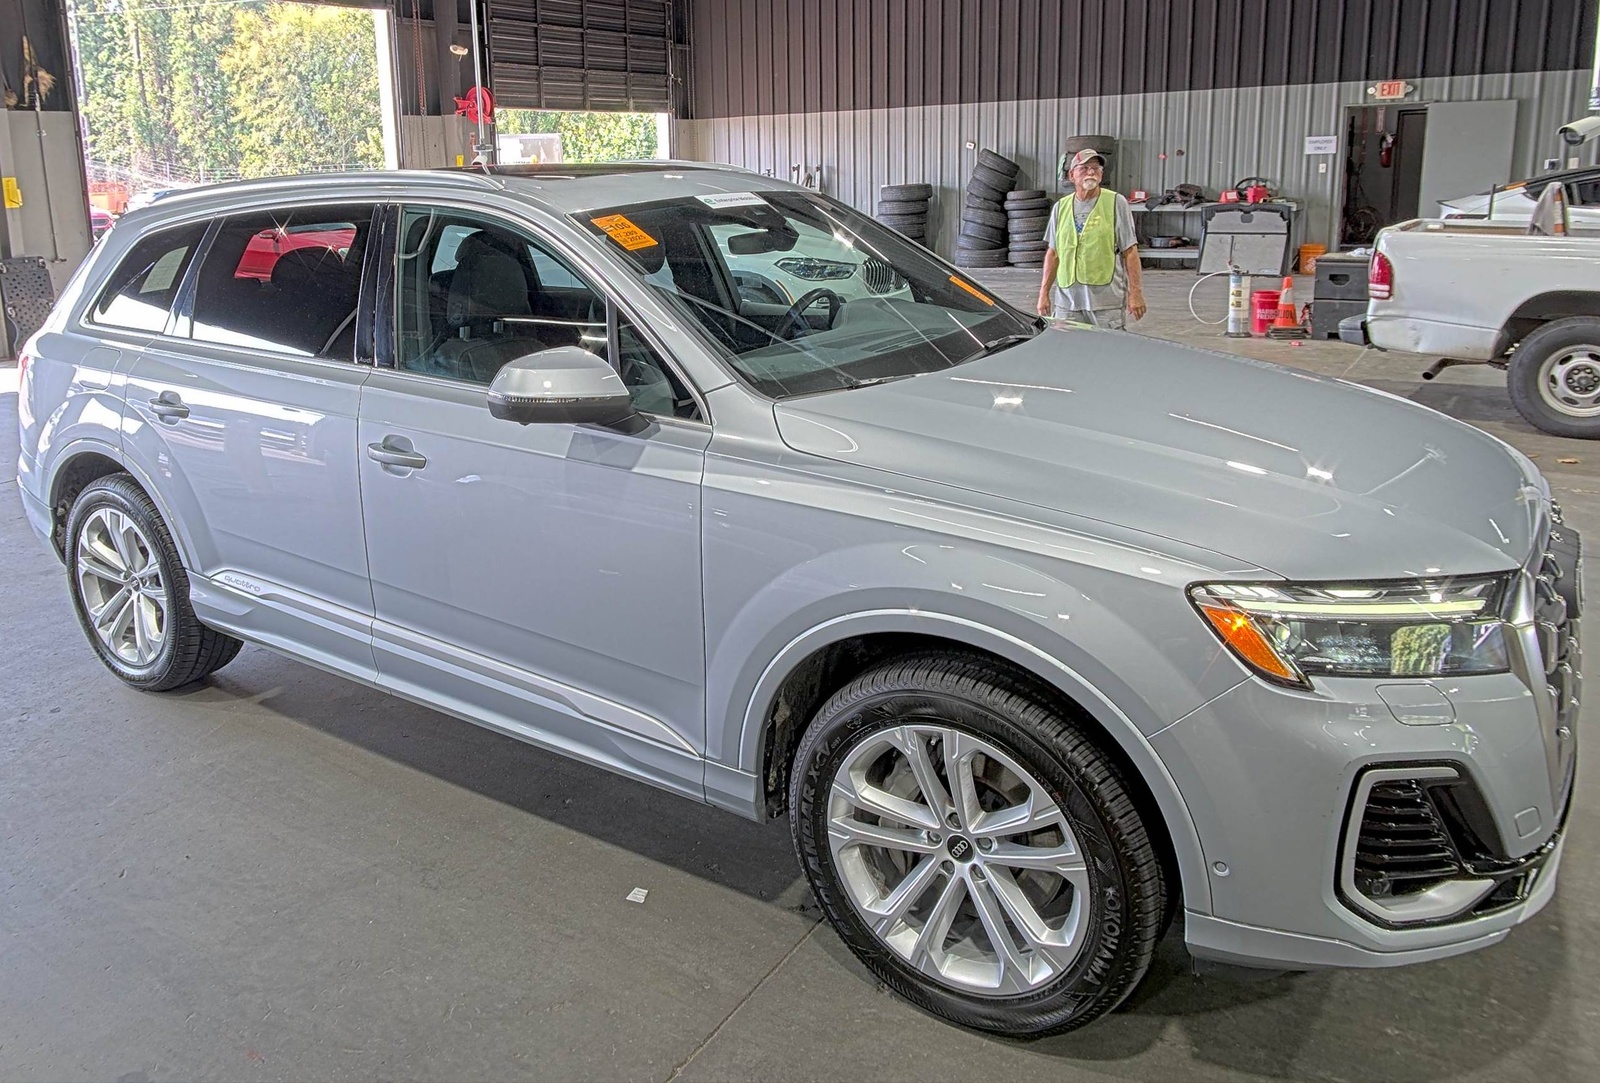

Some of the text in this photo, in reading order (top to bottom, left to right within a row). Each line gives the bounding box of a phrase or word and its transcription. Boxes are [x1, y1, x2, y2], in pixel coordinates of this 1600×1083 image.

[1381, 82, 1401, 96] EXIT
[225, 575, 261, 592] quattro
[1083, 885, 1121, 986] YOKOHAMA
